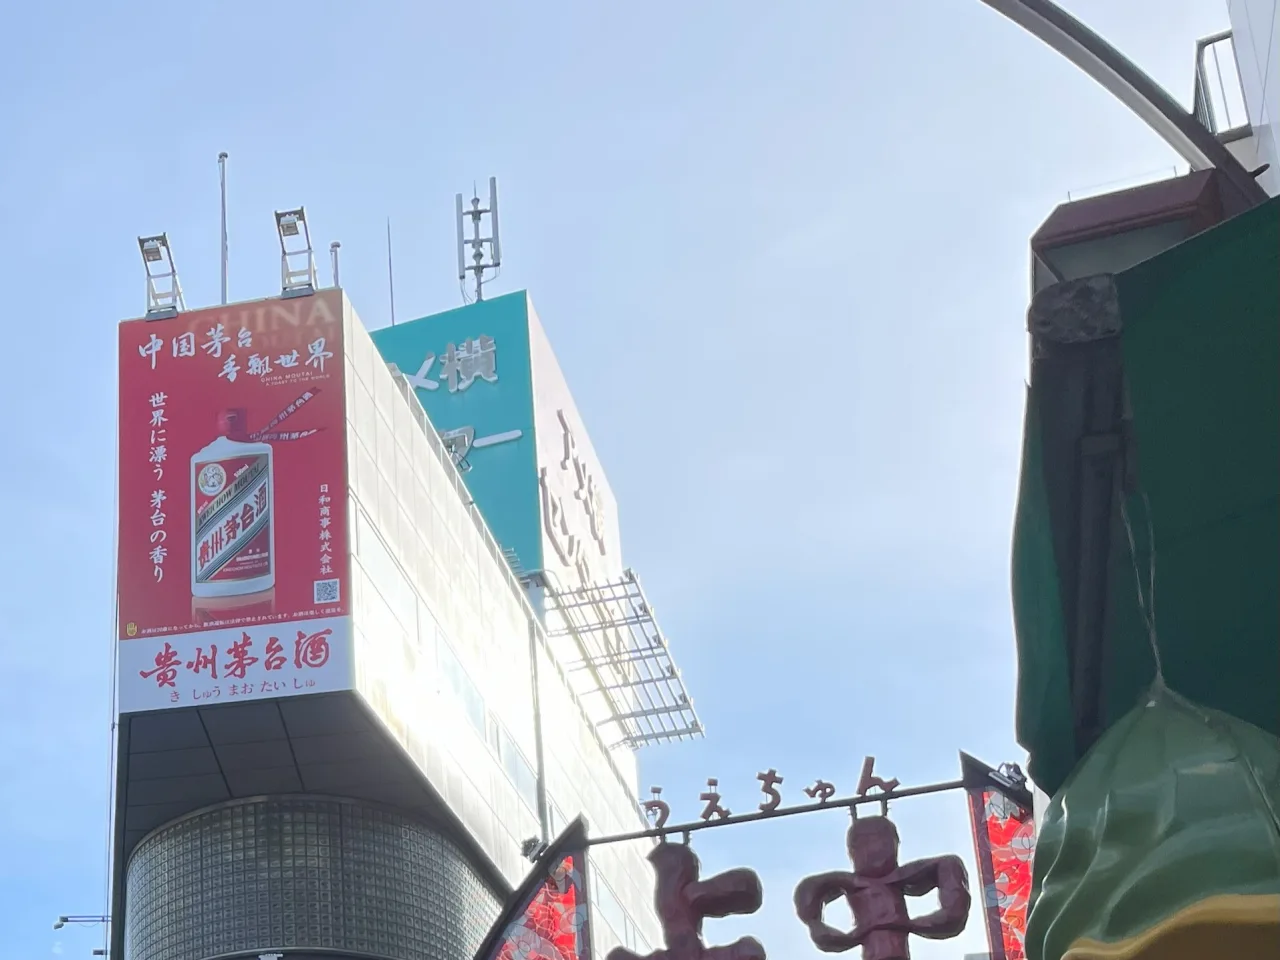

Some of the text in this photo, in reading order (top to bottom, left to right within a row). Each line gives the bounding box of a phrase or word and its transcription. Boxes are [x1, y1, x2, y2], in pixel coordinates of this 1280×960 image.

[149, 391, 169, 583] 世界に漂う 茅台の香り
